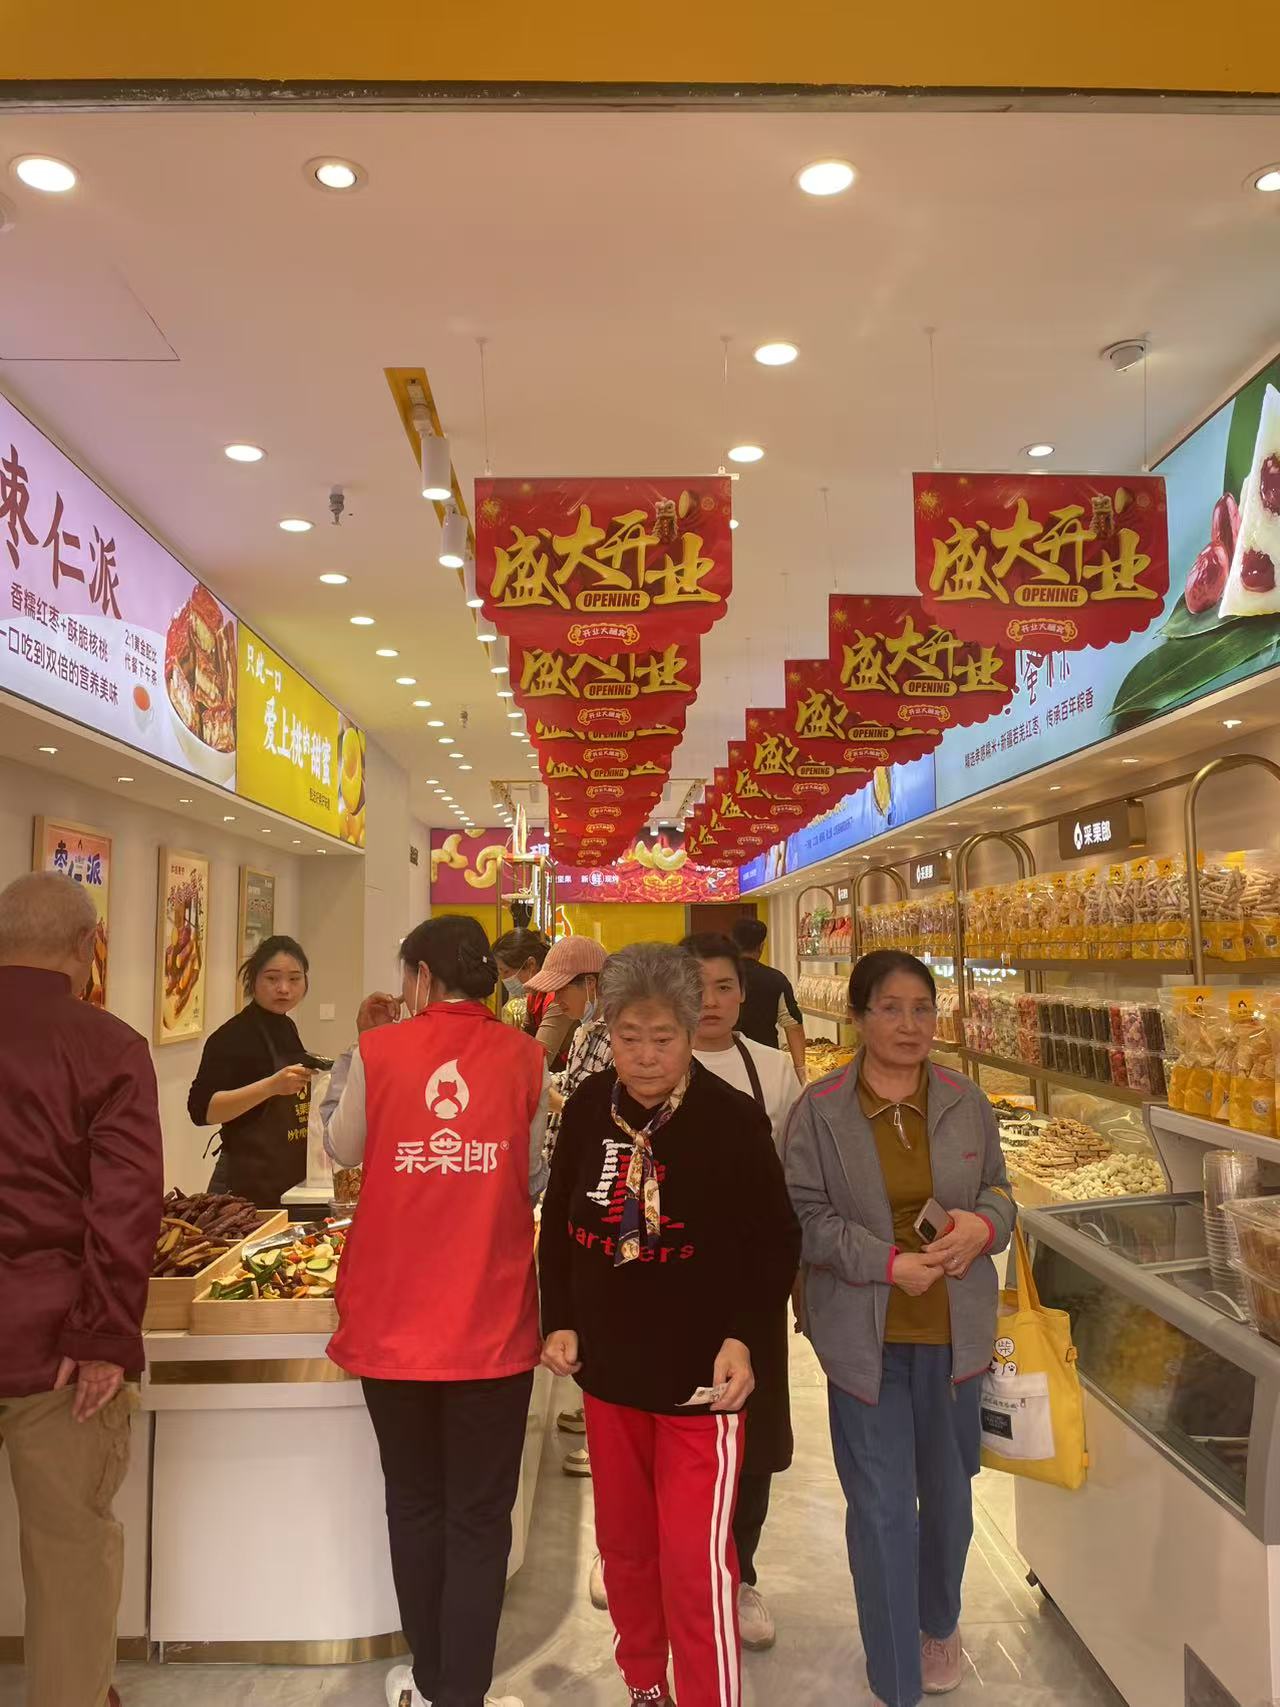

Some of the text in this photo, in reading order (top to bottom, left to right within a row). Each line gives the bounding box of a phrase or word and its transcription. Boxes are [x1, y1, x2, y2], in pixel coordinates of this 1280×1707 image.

[0, 443, 122, 620] 枣仁派
[929, 498, 1158, 604] 盛大开业
[490, 504, 722, 610] 盛大开业
[583, 592, 640, 608] OPENING
[1022, 587, 1078, 602] OPENING
[11, 582, 108, 662] 香糯红枣+酥脆核桃
[0, 626, 119, 706] 一口吃到双倍的营养美味
[245, 644, 282, 692] 只此一口
[840, 615, 1008, 694] 盛大开业
[589, 684, 631, 696] OPENING
[908, 681, 950, 694] OPENING
[852, 729, 889, 738] OPENING
[800, 766, 830, 775] OPENING
[1083, 820, 1112, 845] 采栗郎
[394, 1127, 498, 1175] 采栗郎
